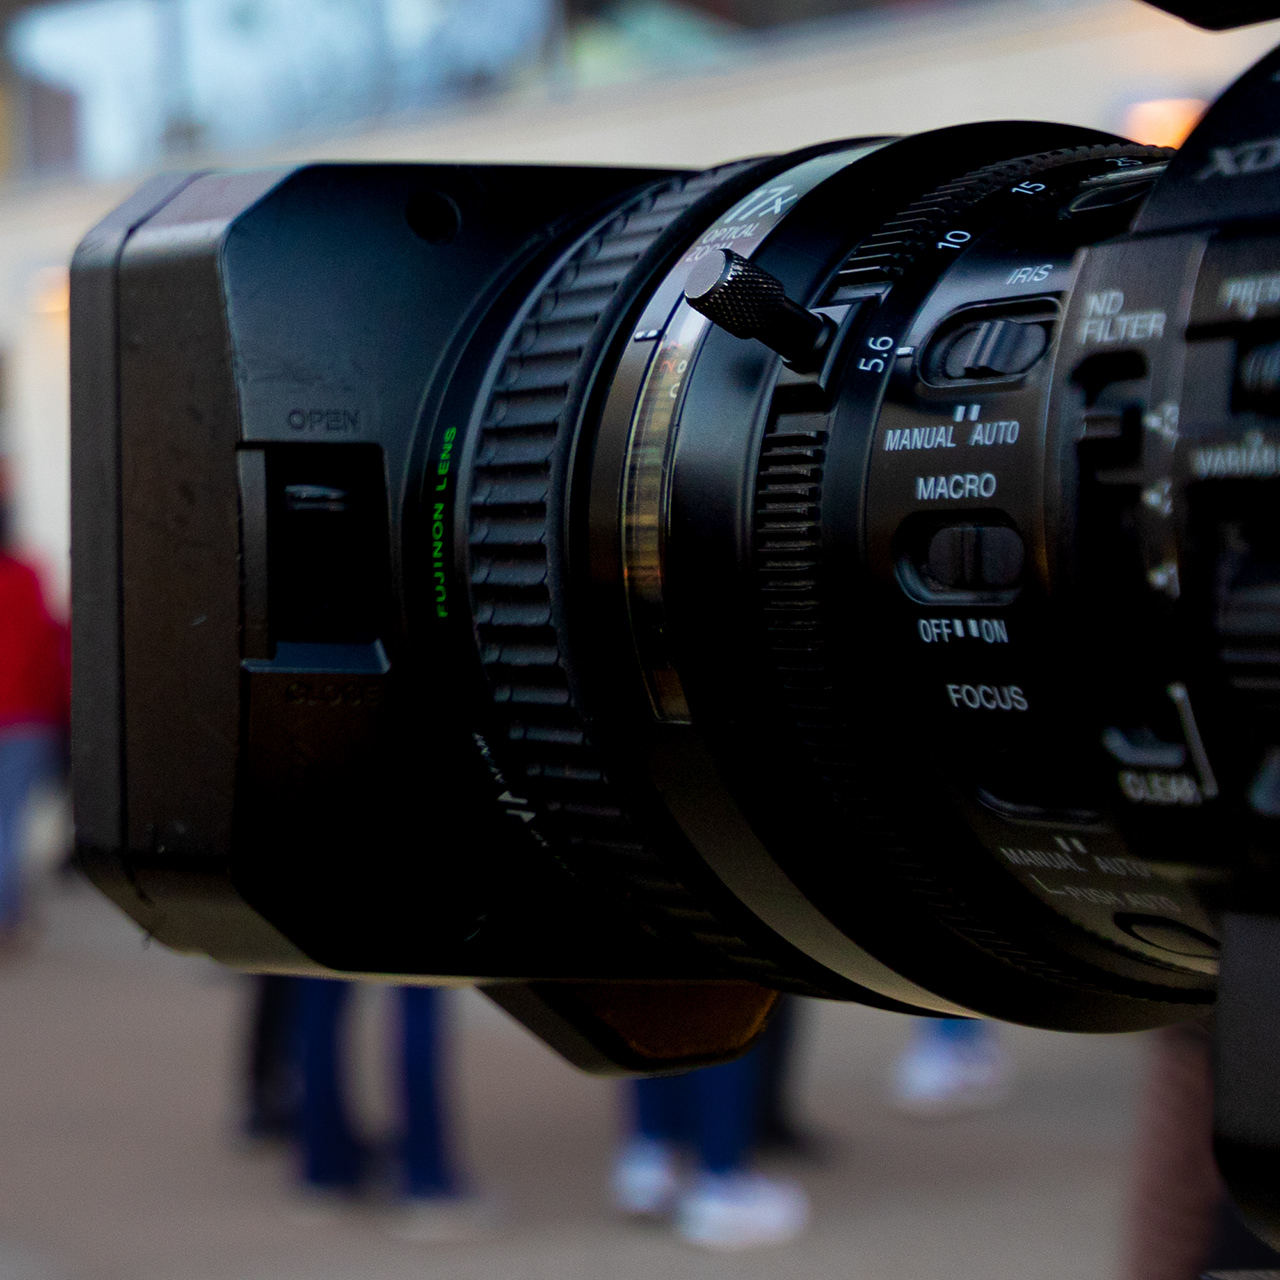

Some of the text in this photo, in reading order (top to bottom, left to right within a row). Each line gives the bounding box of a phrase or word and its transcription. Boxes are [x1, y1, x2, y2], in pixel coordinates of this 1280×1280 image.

[1104, 156, 1144, 169] 25
[1010, 179, 1046, 197] 15
[701, 222, 760, 245] OPTICAL
[936, 228, 973, 251] 10
[1004, 263, 1054, 286] IRIS
[1086, 290, 1125, 317] ND
[1080, 310, 1168, 344] FILTER
[857, 334, 895, 375] 5.6
[287, 408, 361, 431] OPEN
[884, 421, 1021, 452] MANUAL AUTO
[915, 473, 997, 501] MACRO
[431, 425, 458, 619] FUJINON LENS
[917, 618, 1010, 645] OFF ON
[944, 682, 1030, 712] FOCUS
[999, 847, 1153, 879] MANUAL AUTO
[1063, 885, 1182, 913] PUSH AUTO
